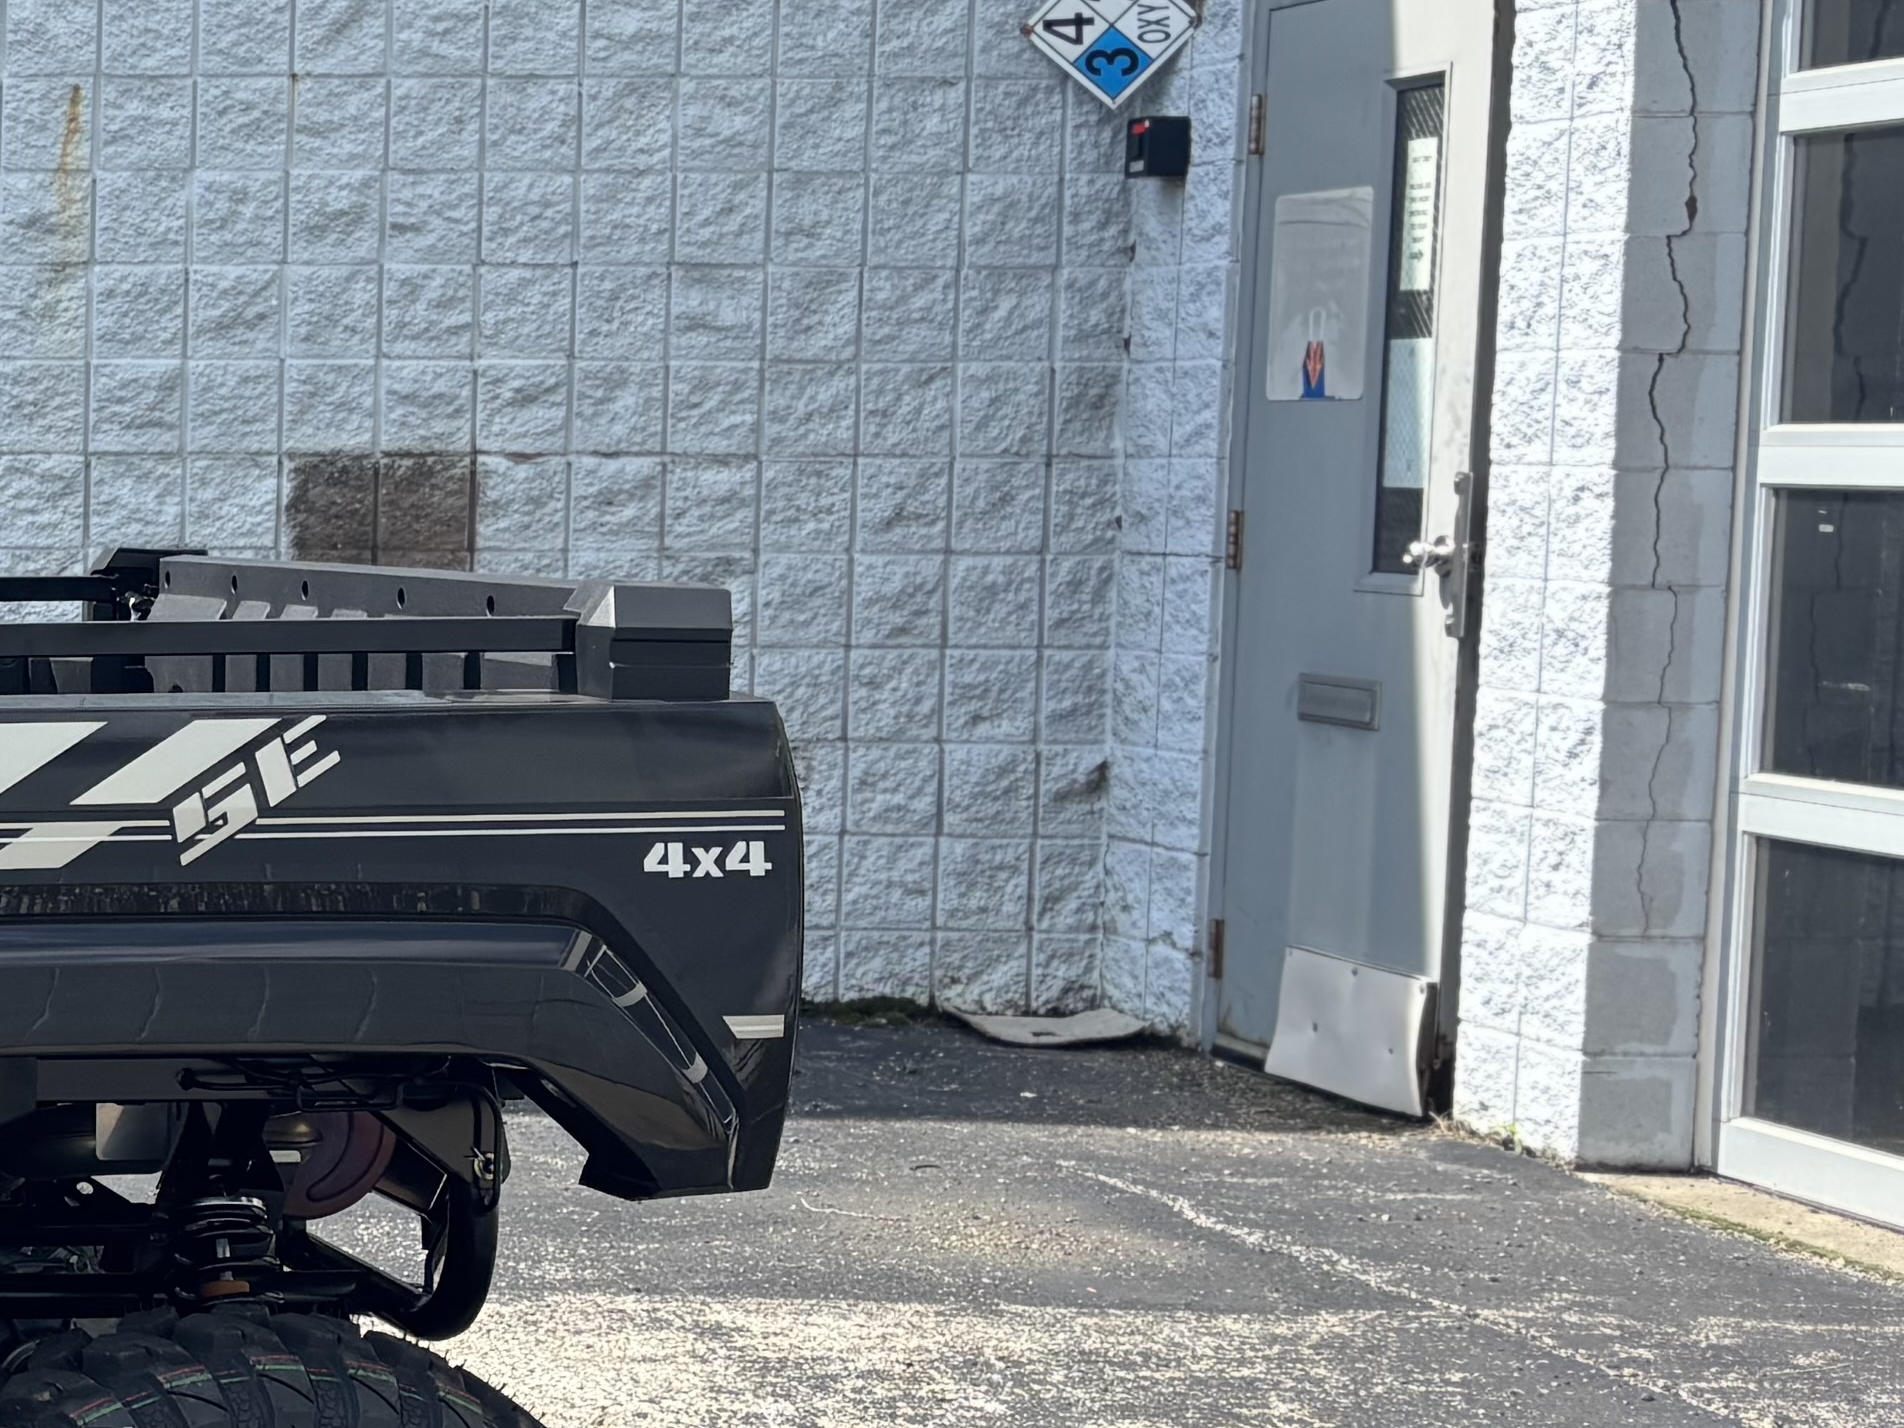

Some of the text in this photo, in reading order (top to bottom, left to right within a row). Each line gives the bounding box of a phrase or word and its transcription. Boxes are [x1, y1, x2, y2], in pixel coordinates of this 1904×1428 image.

[1043, 12, 1095, 46] 4
[1137, 4, 1172, 44] OXY
[1085, 48, 1139, 76] 3
[172, 714, 341, 866] SE
[643, 840, 773, 878] 4x4
